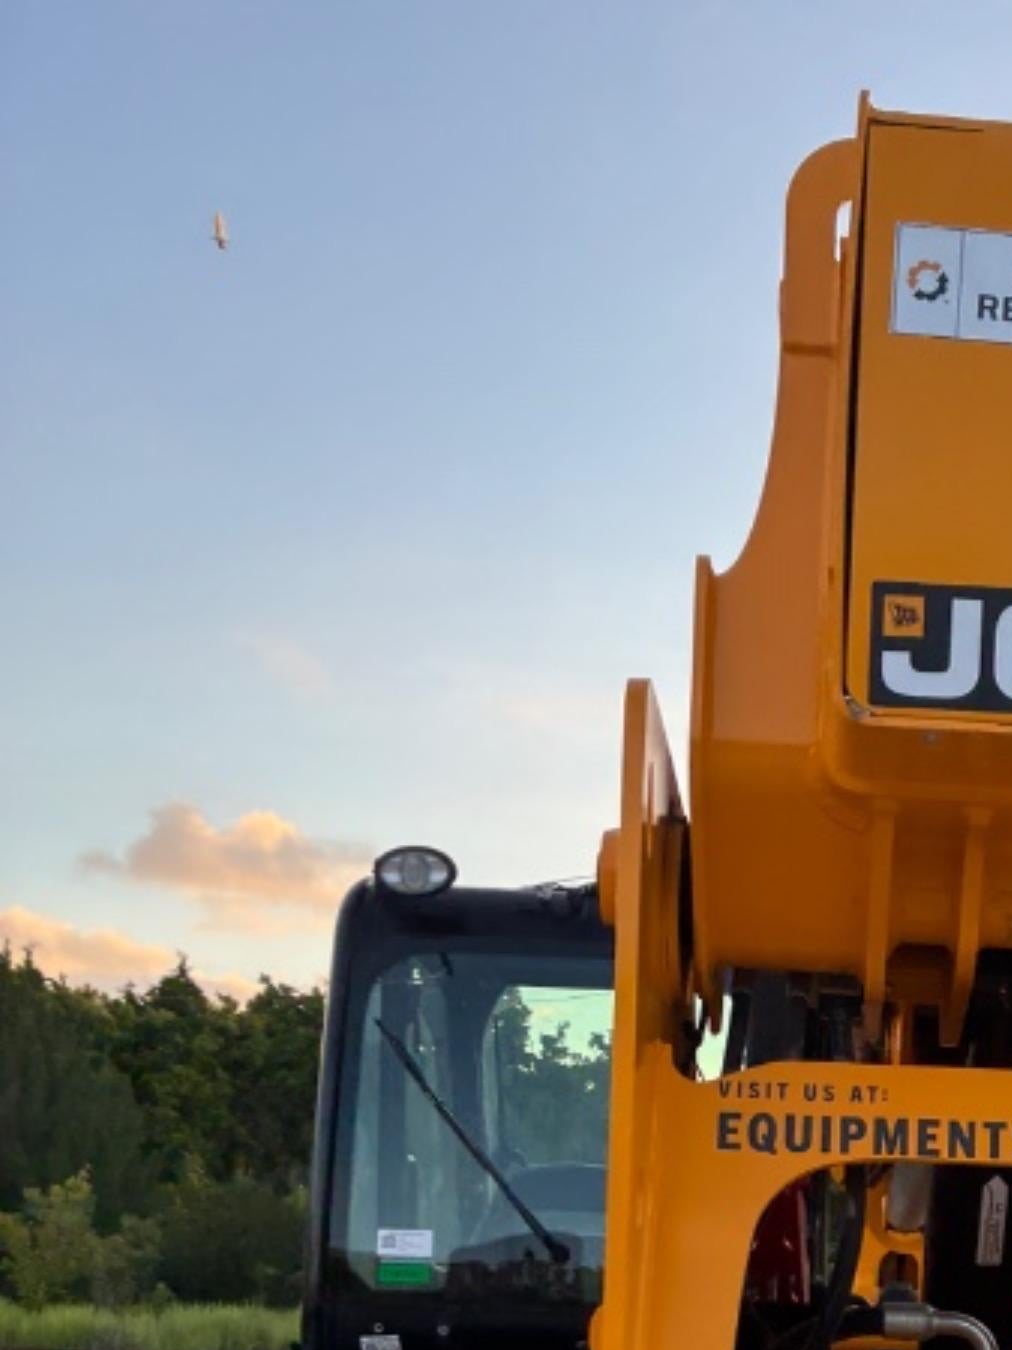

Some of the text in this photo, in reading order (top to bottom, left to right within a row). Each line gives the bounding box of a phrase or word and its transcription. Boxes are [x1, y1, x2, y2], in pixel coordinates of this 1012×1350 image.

[718, 1081, 889, 1104] VISIT US AT:
